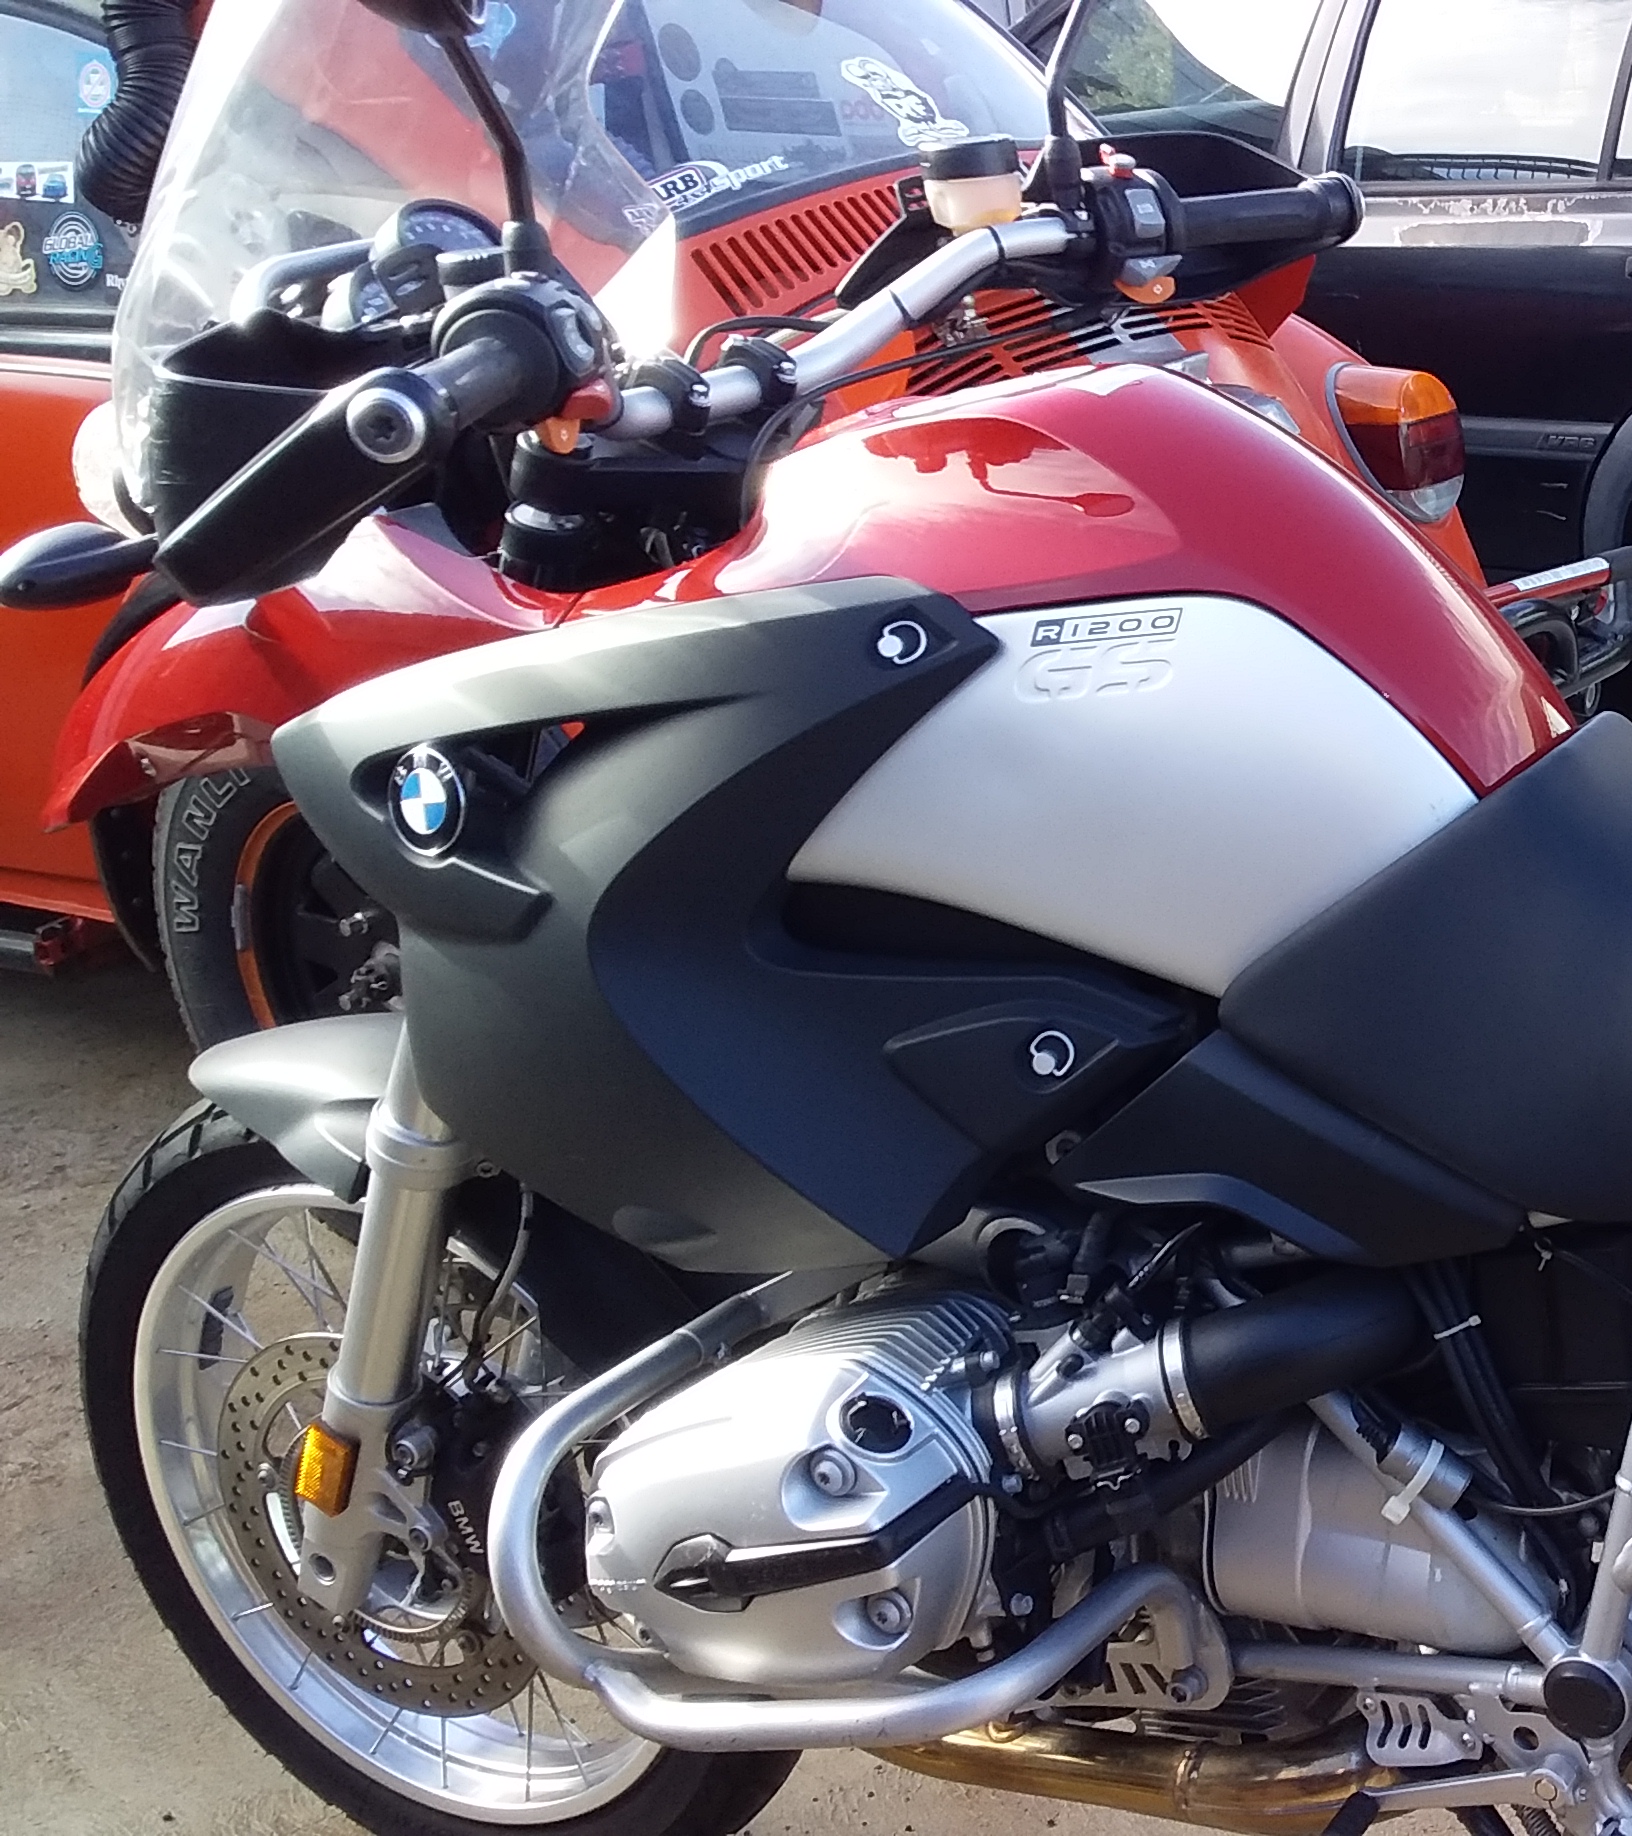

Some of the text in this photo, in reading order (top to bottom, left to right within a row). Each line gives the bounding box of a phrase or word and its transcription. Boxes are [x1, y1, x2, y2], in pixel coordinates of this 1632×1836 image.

[42, 232, 97, 254] GLOBAL
[1033, 613, 1176, 644] R1200
[1014, 638, 1174, 703] GS
[447, 1500, 485, 1554] BMW
